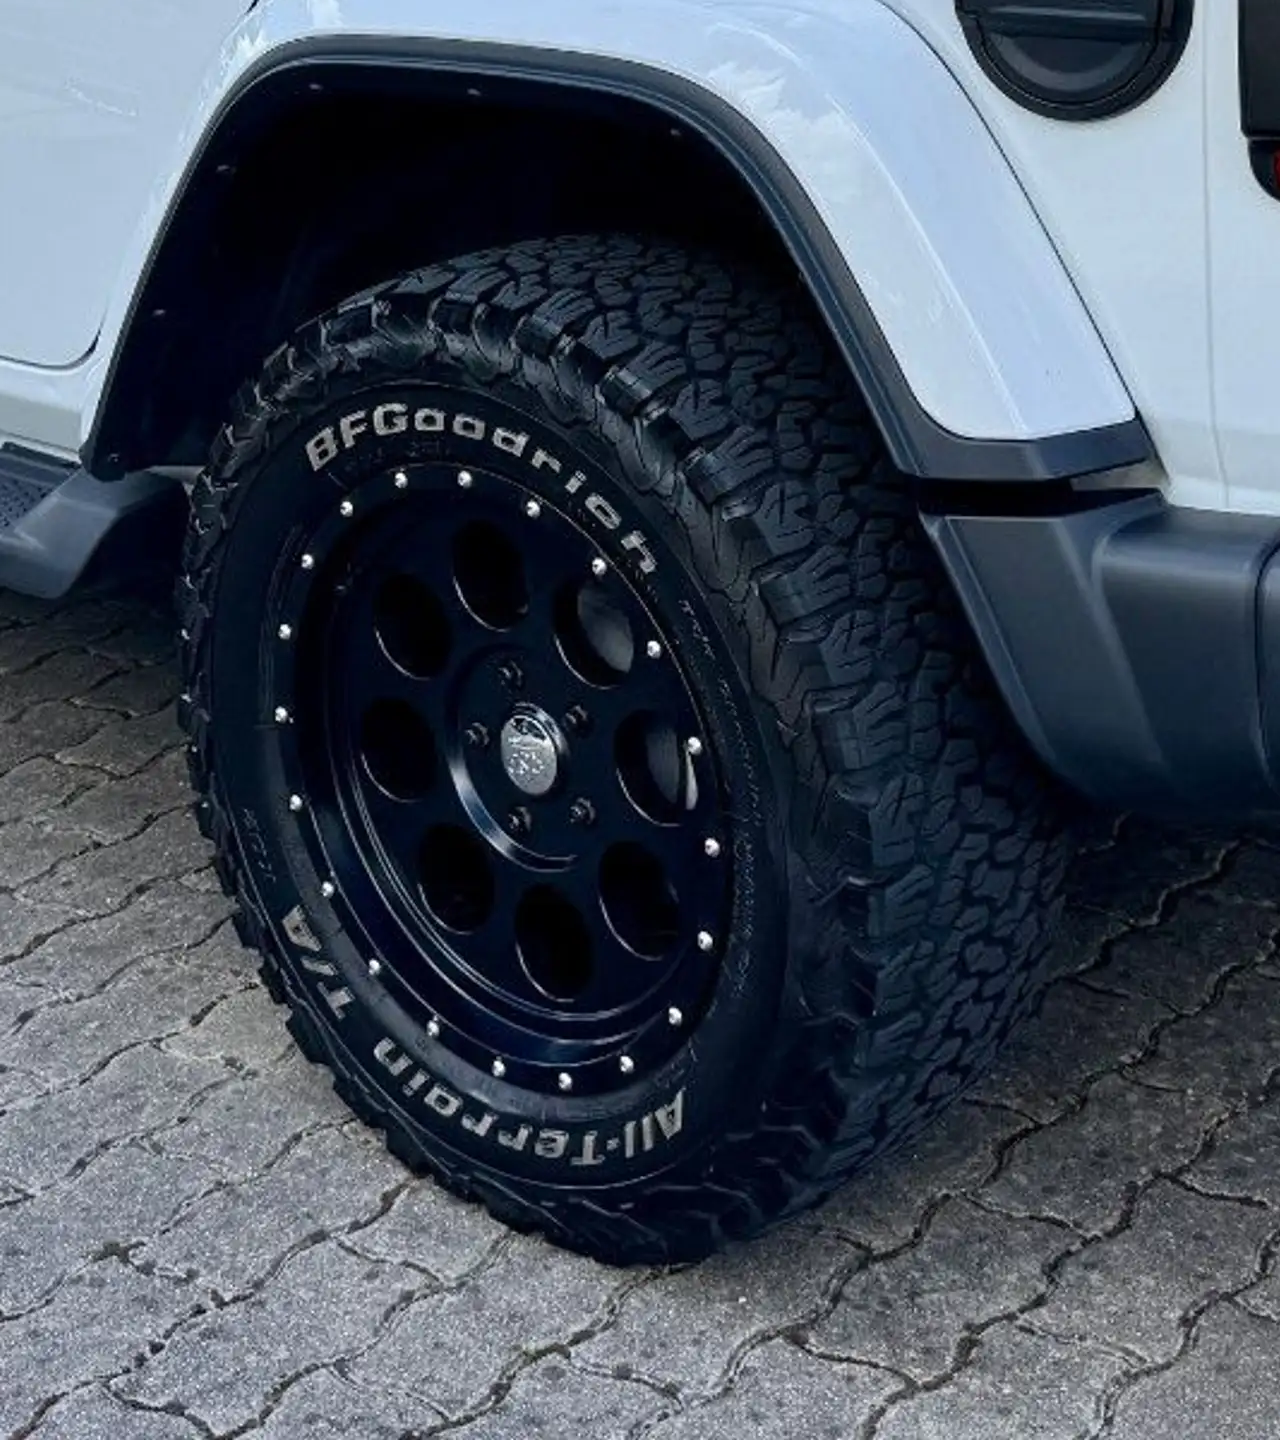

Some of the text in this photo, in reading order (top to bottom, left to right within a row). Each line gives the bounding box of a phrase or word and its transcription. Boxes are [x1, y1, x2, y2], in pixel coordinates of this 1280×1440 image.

[304, 402, 656, 574] BFGoodrich
[281, 904, 686, 1166] All-Terrain T/A
